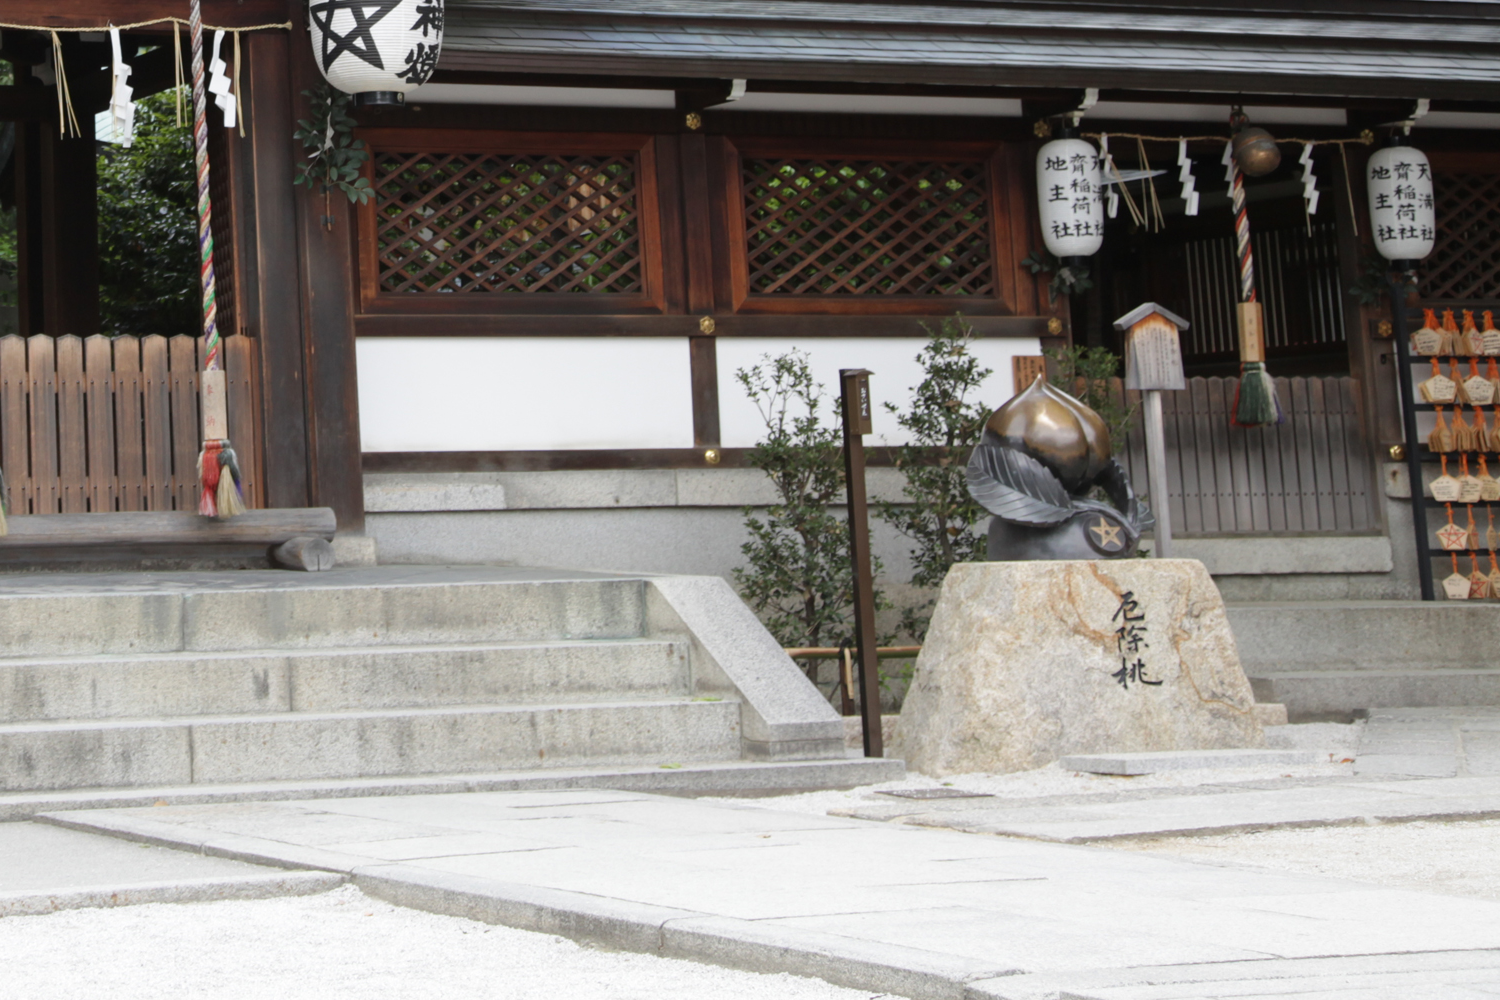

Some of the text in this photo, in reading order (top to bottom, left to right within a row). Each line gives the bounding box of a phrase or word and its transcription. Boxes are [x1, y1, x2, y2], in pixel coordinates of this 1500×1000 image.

[1045, 156, 1074, 239] 地主社
[1371, 166, 1397, 242] 地主社
[1111, 591, 1164, 690] 厄除桃
